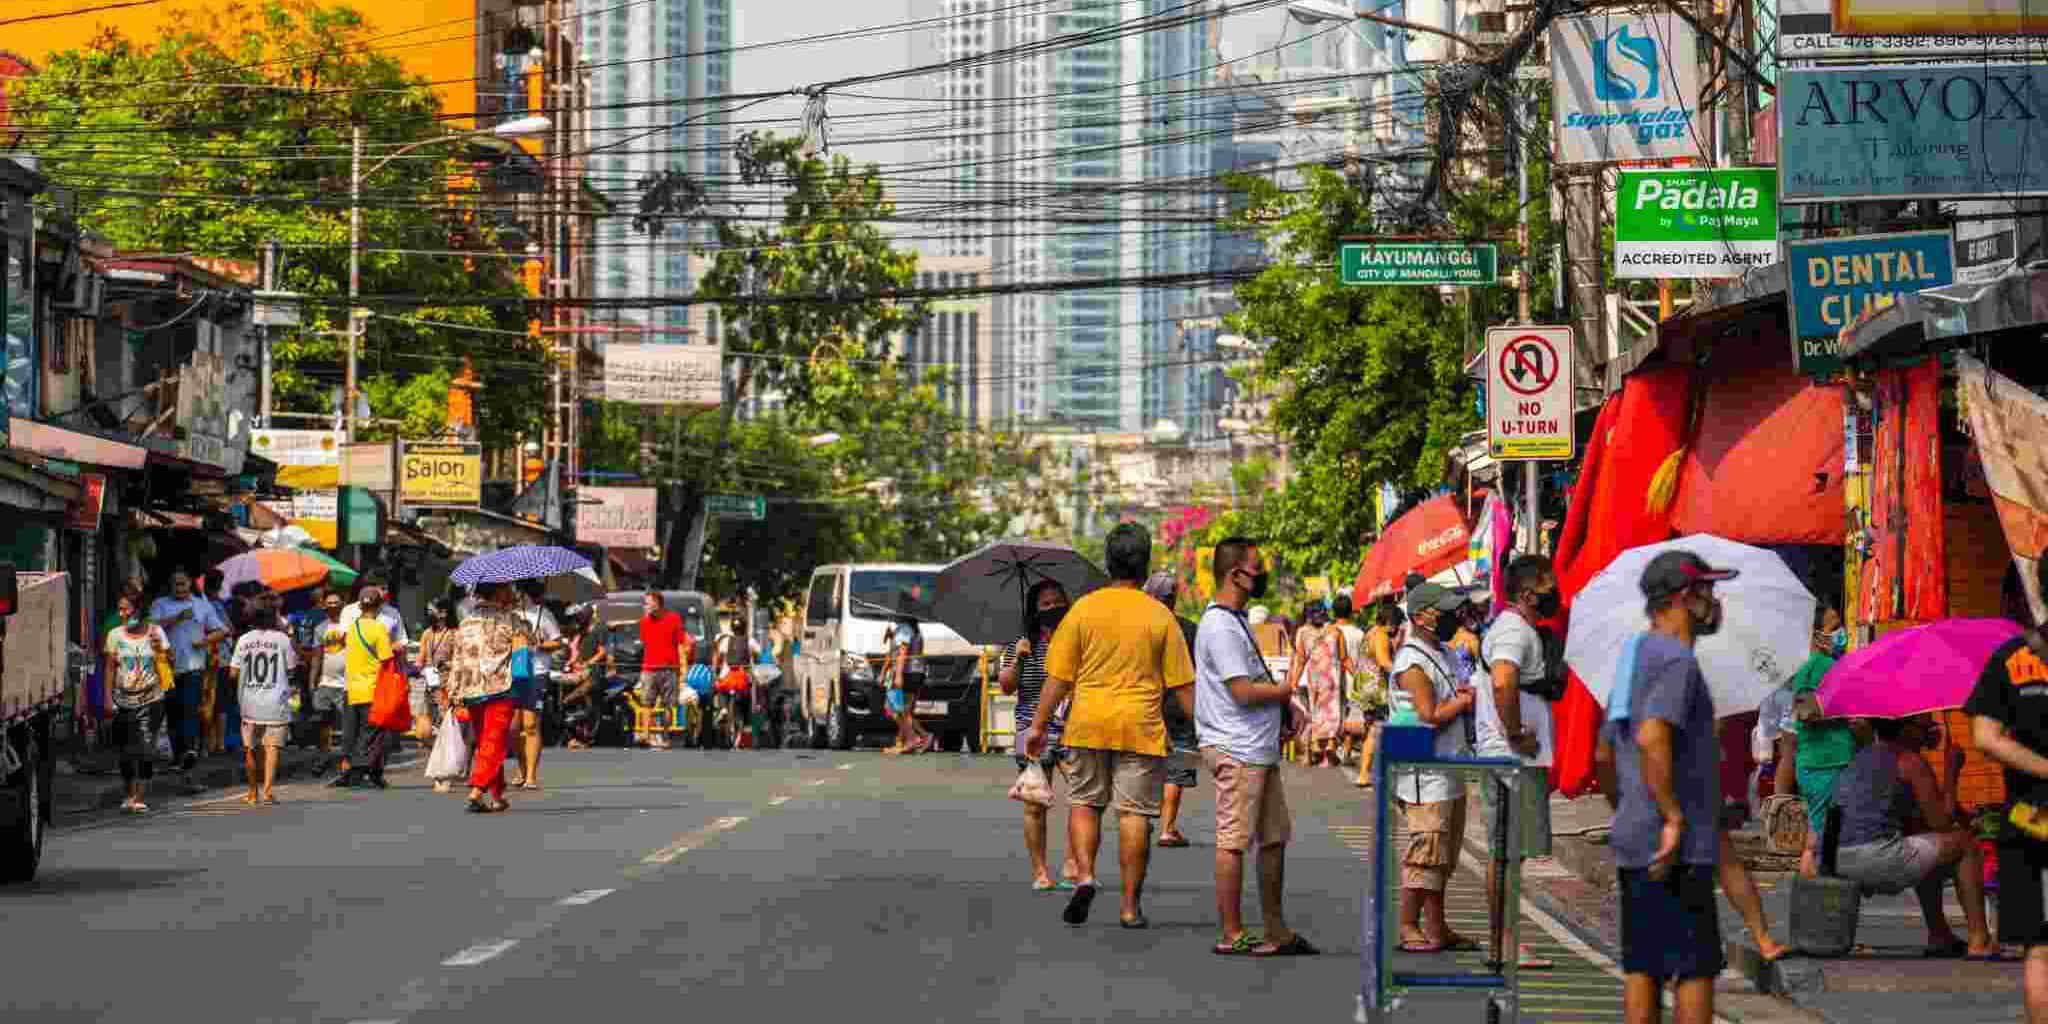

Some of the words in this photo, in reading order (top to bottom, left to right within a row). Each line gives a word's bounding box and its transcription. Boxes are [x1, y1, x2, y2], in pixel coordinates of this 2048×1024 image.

[1795, 75, 2037, 127] ARVOX
[1636, 122, 1684, 145] gaz
[1634, 178, 1760, 210] Padala
[1659, 217, 1673, 229] by
[1699, 214, 1760, 229] PayMaya
[1360, 250, 1479, 266] KAYUMANGGI
[1622, 253, 1718, 266] ACCREDITED
[1721, 252, 1772, 266] AGENT
[1357, 269, 1379, 279] CITY
[1383, 269, 1397, 279] OF
[1808, 250, 1936, 288] DENTAL
[1519, 402, 1541, 416] NO
[1502, 420, 1558, 434] U-TURN
[406, 456, 465, 480] Salon
[244, 651, 279, 684] 101
